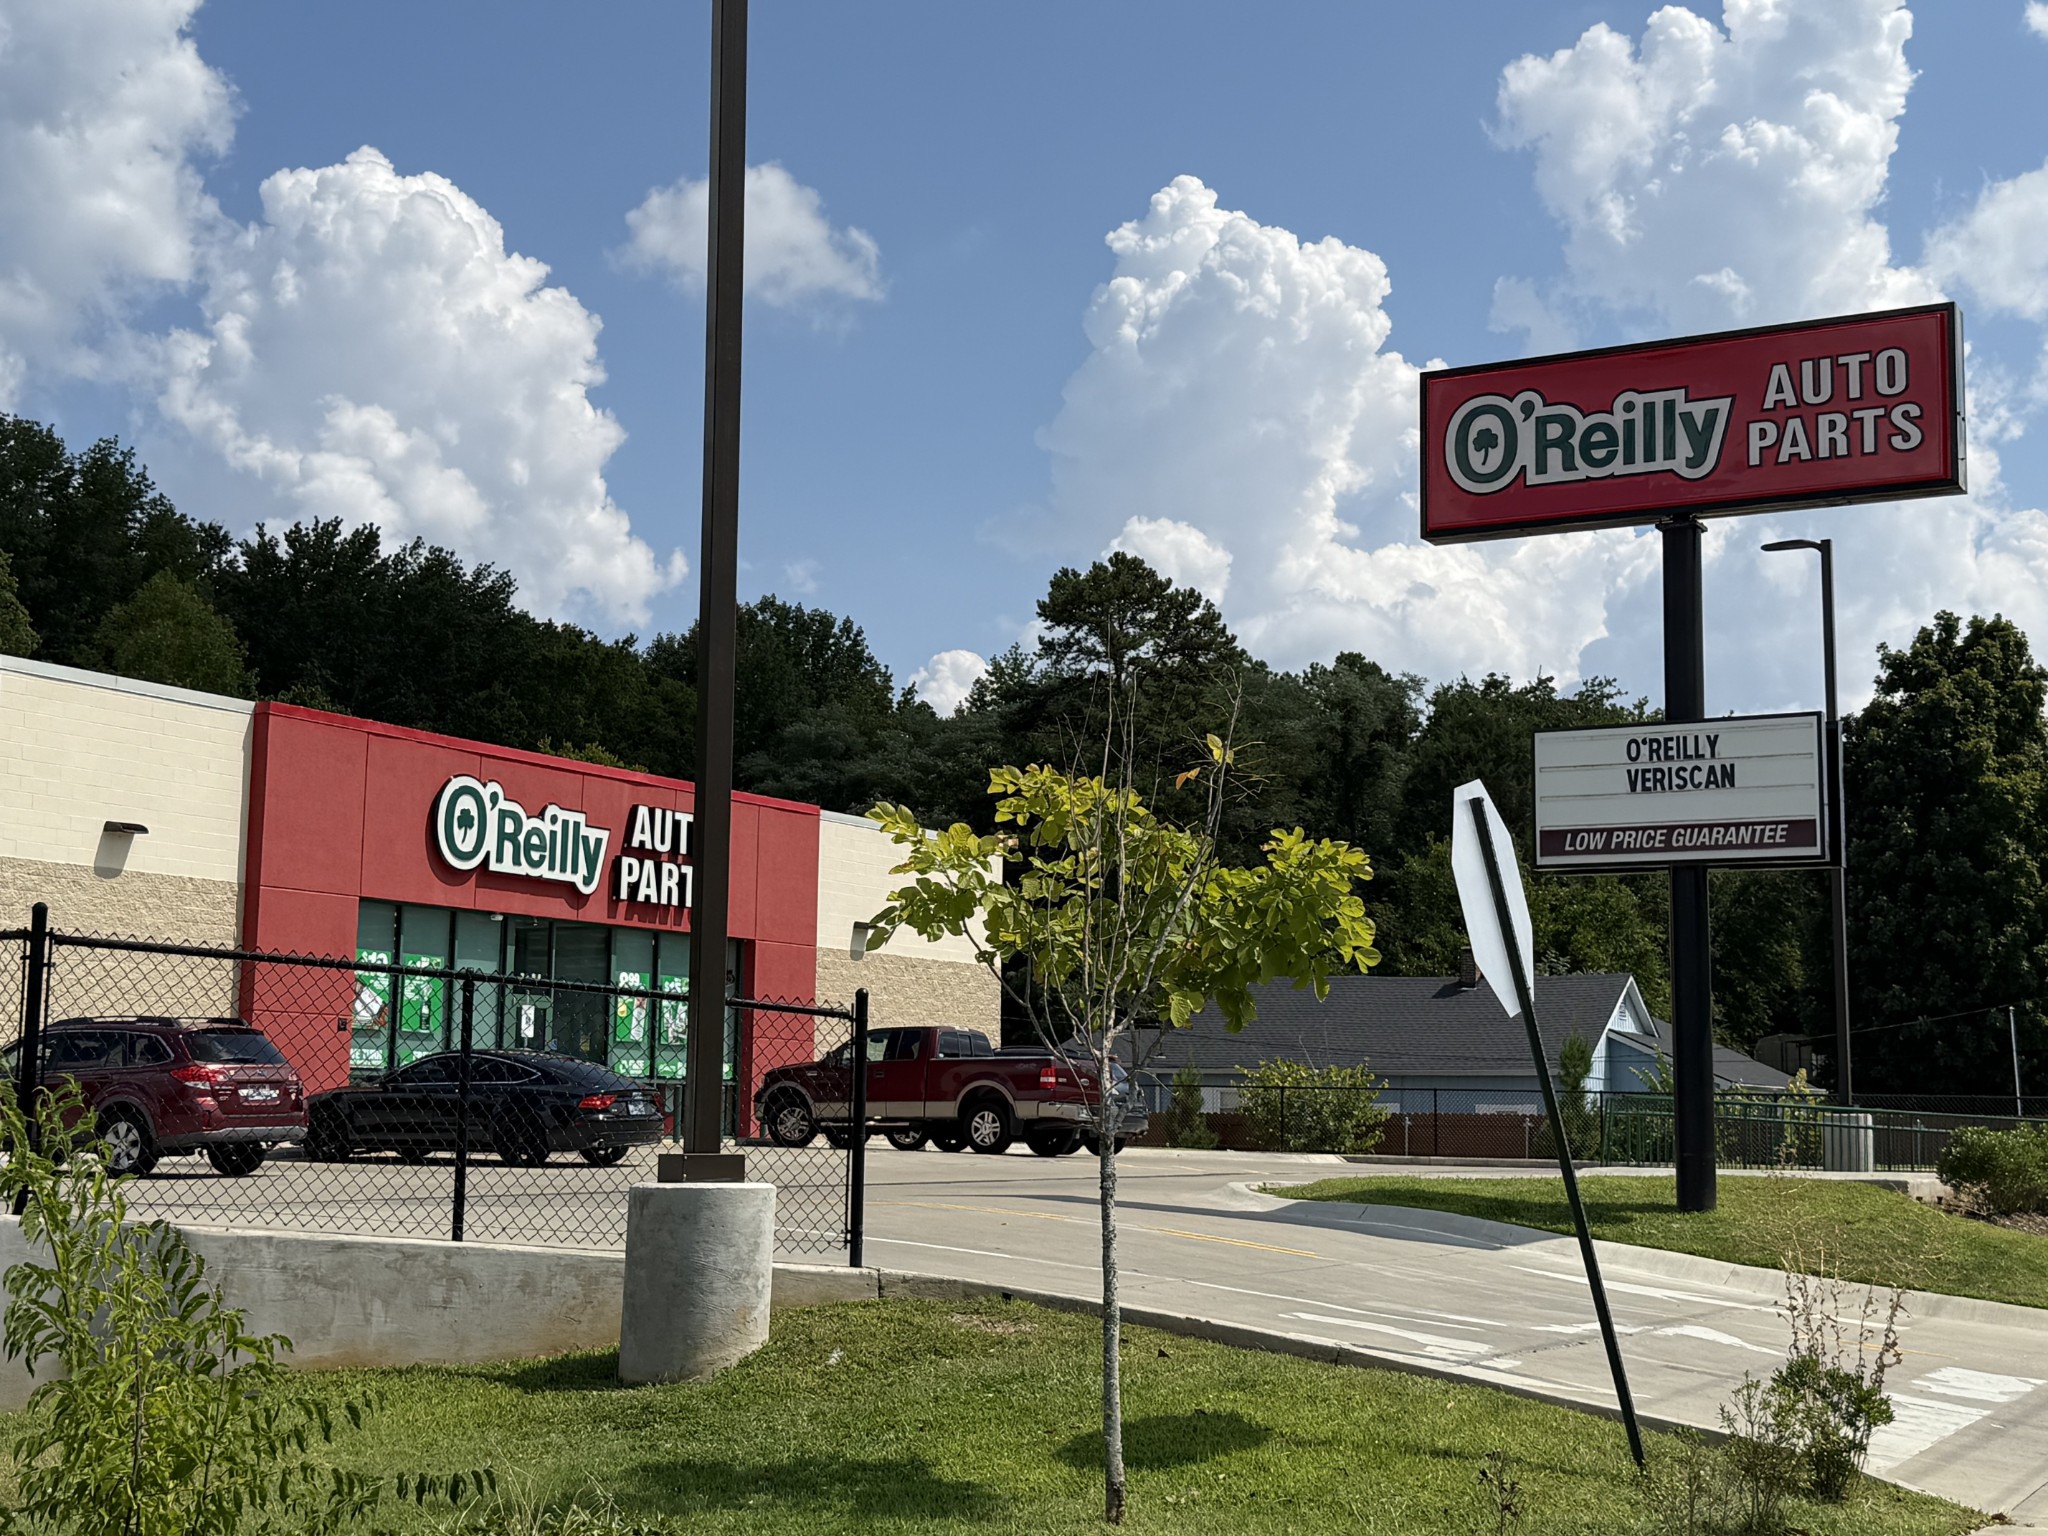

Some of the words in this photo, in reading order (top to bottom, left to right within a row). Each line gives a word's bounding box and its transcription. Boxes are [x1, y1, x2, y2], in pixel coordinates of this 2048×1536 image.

[1763, 347, 1907, 409] AUTO
[1453, 397, 1721, 484] O'Reilly
[1747, 403, 1922, 467] PARTS
[1626, 733, 1720, 762] O'REILLY
[1626, 763, 1736, 793] VERISCAN
[443, 784, 604, 887] O'Reilly
[631, 804, 694, 855] AUT
[1565, 831, 1607, 851] LOW
[1611, 829, 1667, 849] PRICE
[1671, 824, 1789, 847] GUARANTEE
[619, 856, 694, 908] PART
